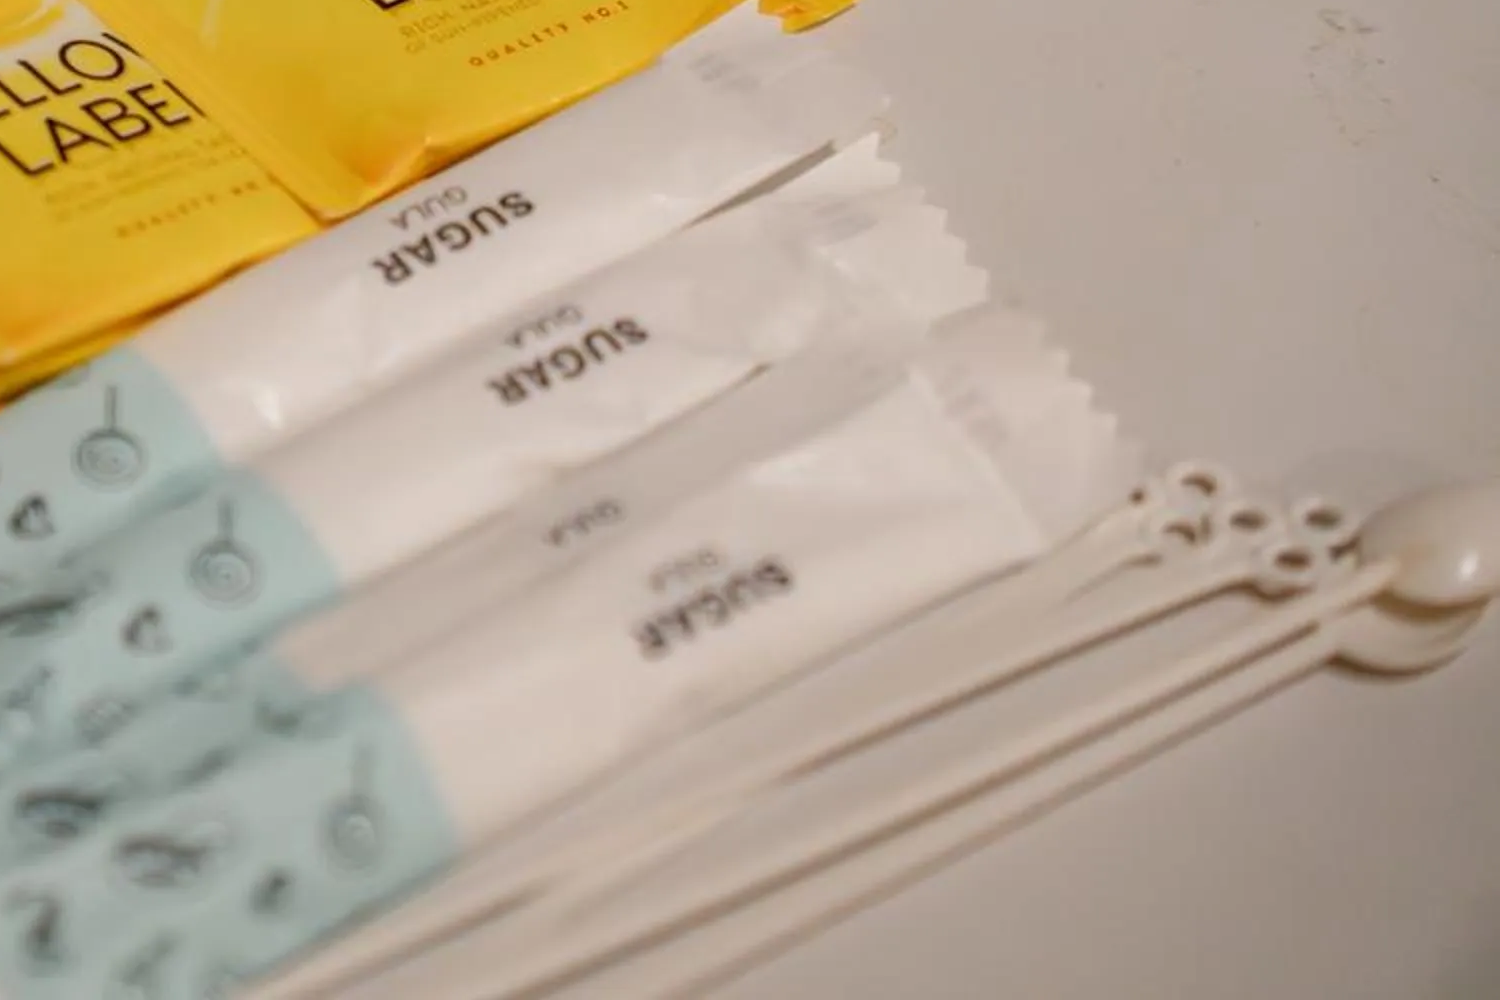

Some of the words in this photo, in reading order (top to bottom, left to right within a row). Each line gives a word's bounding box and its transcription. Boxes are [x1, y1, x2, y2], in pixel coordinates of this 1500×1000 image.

[468, 23, 569, 67] QUALITY
[371, 190, 537, 287] SUGAR
[390, 185, 469, 231] GULA
[485, 315, 650, 407] SUGAR
[632, 554, 793, 662] SUGAR
